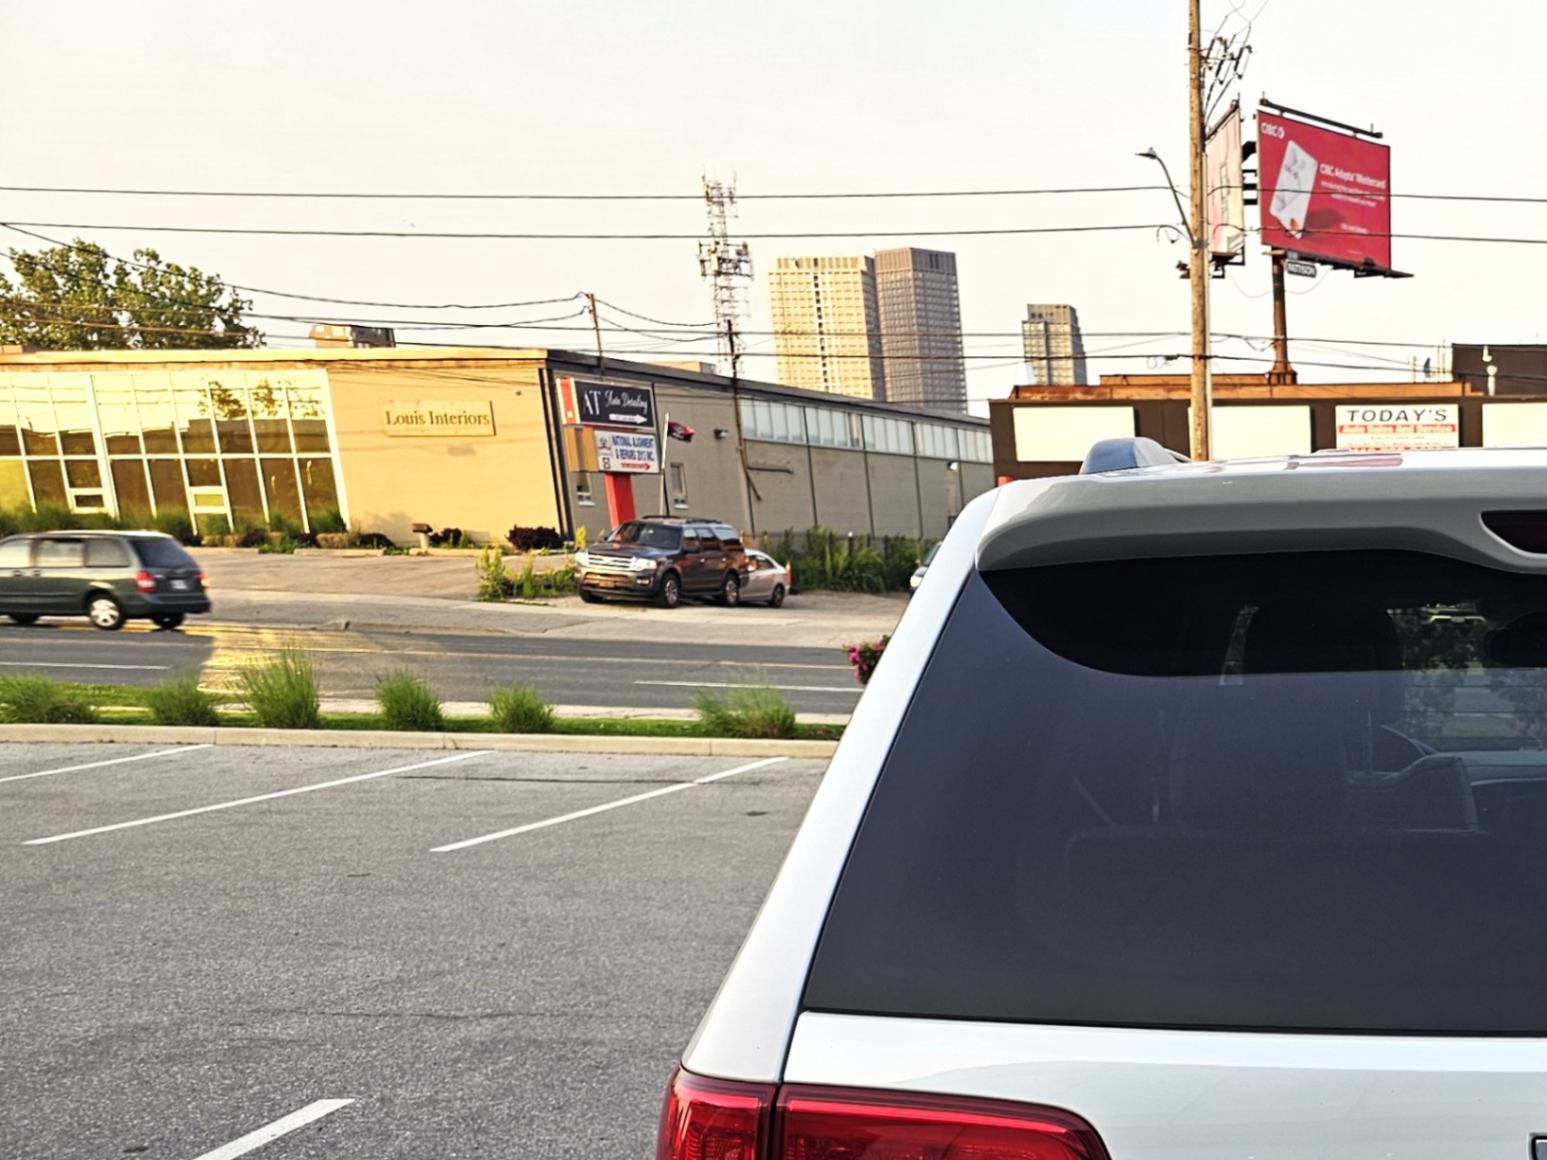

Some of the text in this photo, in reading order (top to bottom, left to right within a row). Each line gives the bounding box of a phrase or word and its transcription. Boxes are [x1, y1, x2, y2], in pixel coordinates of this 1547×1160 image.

[1261, 122, 1279, 137] CIBC
[1320, 163, 1335, 176] CIBC
[582, 390, 601, 416] AT
[385, 410, 490, 425] Louis Interiors
[1347, 409, 1447, 422] TODAY'S
